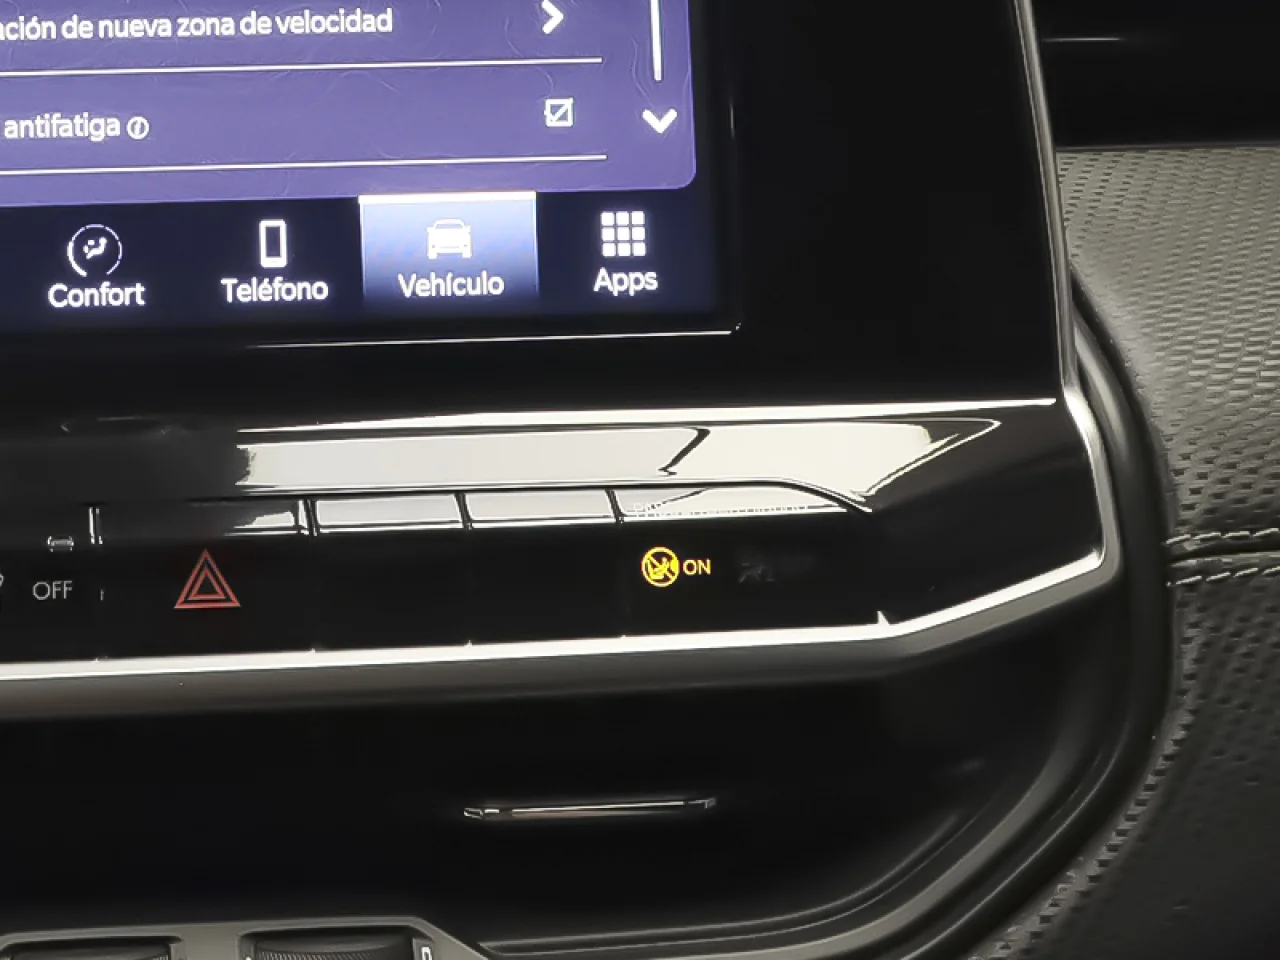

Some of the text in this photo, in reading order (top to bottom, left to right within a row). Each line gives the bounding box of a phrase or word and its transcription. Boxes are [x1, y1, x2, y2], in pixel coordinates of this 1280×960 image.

[60, 13, 93, 39] de
[98, 18, 172, 38] nueva
[176, 16, 235, 37] zona
[239, 10, 272, 35] de
[274, 7, 392, 34] velocidad
[3, 111, 120, 141] antifatiga
[47, 281, 145, 307] Confort
[220, 276, 328, 302] Teléfono
[397, 269, 504, 297] Vehículo
[593, 266, 658, 296] Apps
[682, 558, 710, 575] ON
[32, 580, 72, 600] OFF
